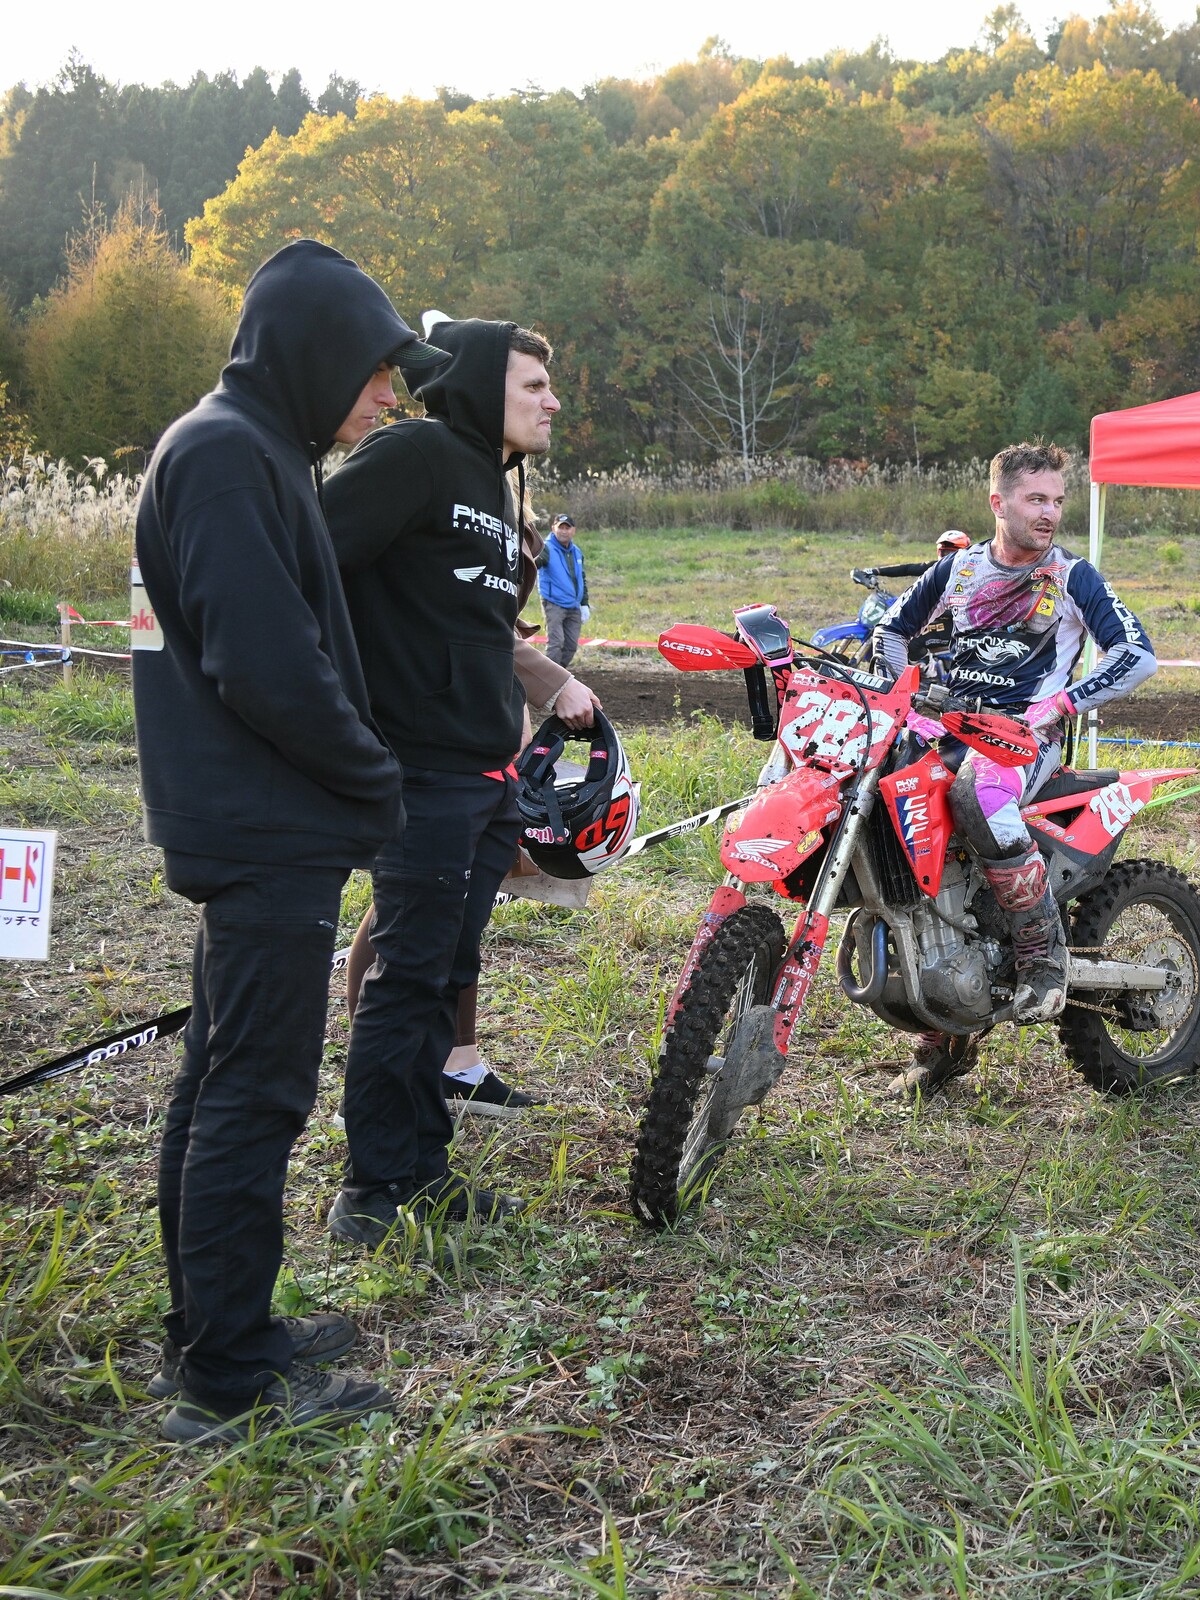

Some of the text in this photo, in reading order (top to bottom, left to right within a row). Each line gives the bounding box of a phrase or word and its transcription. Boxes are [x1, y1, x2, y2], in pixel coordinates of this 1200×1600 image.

[1031, 572, 1063, 588] HODA
[660, 640, 713, 657] ACERBIS
[959, 669, 1017, 688] HONDA
[780, 690, 895, 768] 282
[903, 794, 930, 841] CRF
[1088, 782, 1145, 838] 282
[0, 845, 39, 903] ード
[728, 851, 781, 873] HONDA
